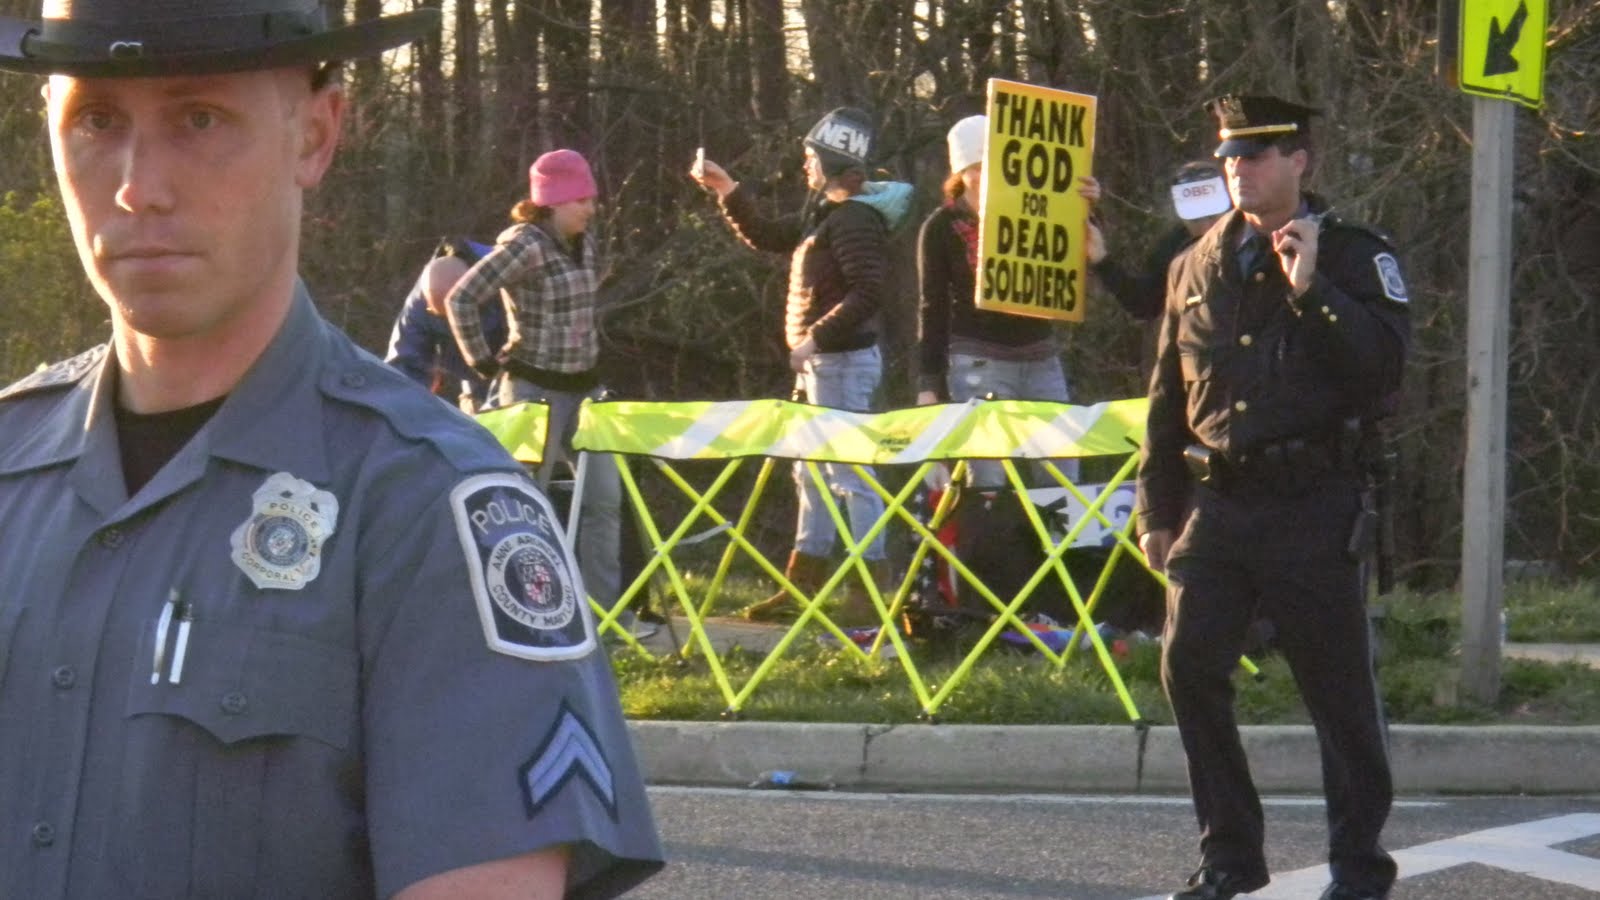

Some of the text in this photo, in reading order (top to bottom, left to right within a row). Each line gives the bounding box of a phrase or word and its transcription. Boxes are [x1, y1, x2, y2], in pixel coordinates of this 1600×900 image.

[995, 91, 1086, 148] THANK
[815, 121, 870, 158] NEW
[1002, 139, 1073, 193] GOD
[1022, 191, 1048, 218] FOR
[1182, 184, 1216, 198] OBEY
[997, 215, 1068, 263] DEAD
[983, 257, 1077, 312] SOLDIERS
[269, 502, 318, 529] POLICE
[471, 499, 551, 535] POLICE
[242, 552, 296, 582] CORPORAL
[492, 540, 513, 572] ANNE
[492, 584, 537, 624] COUNTY
